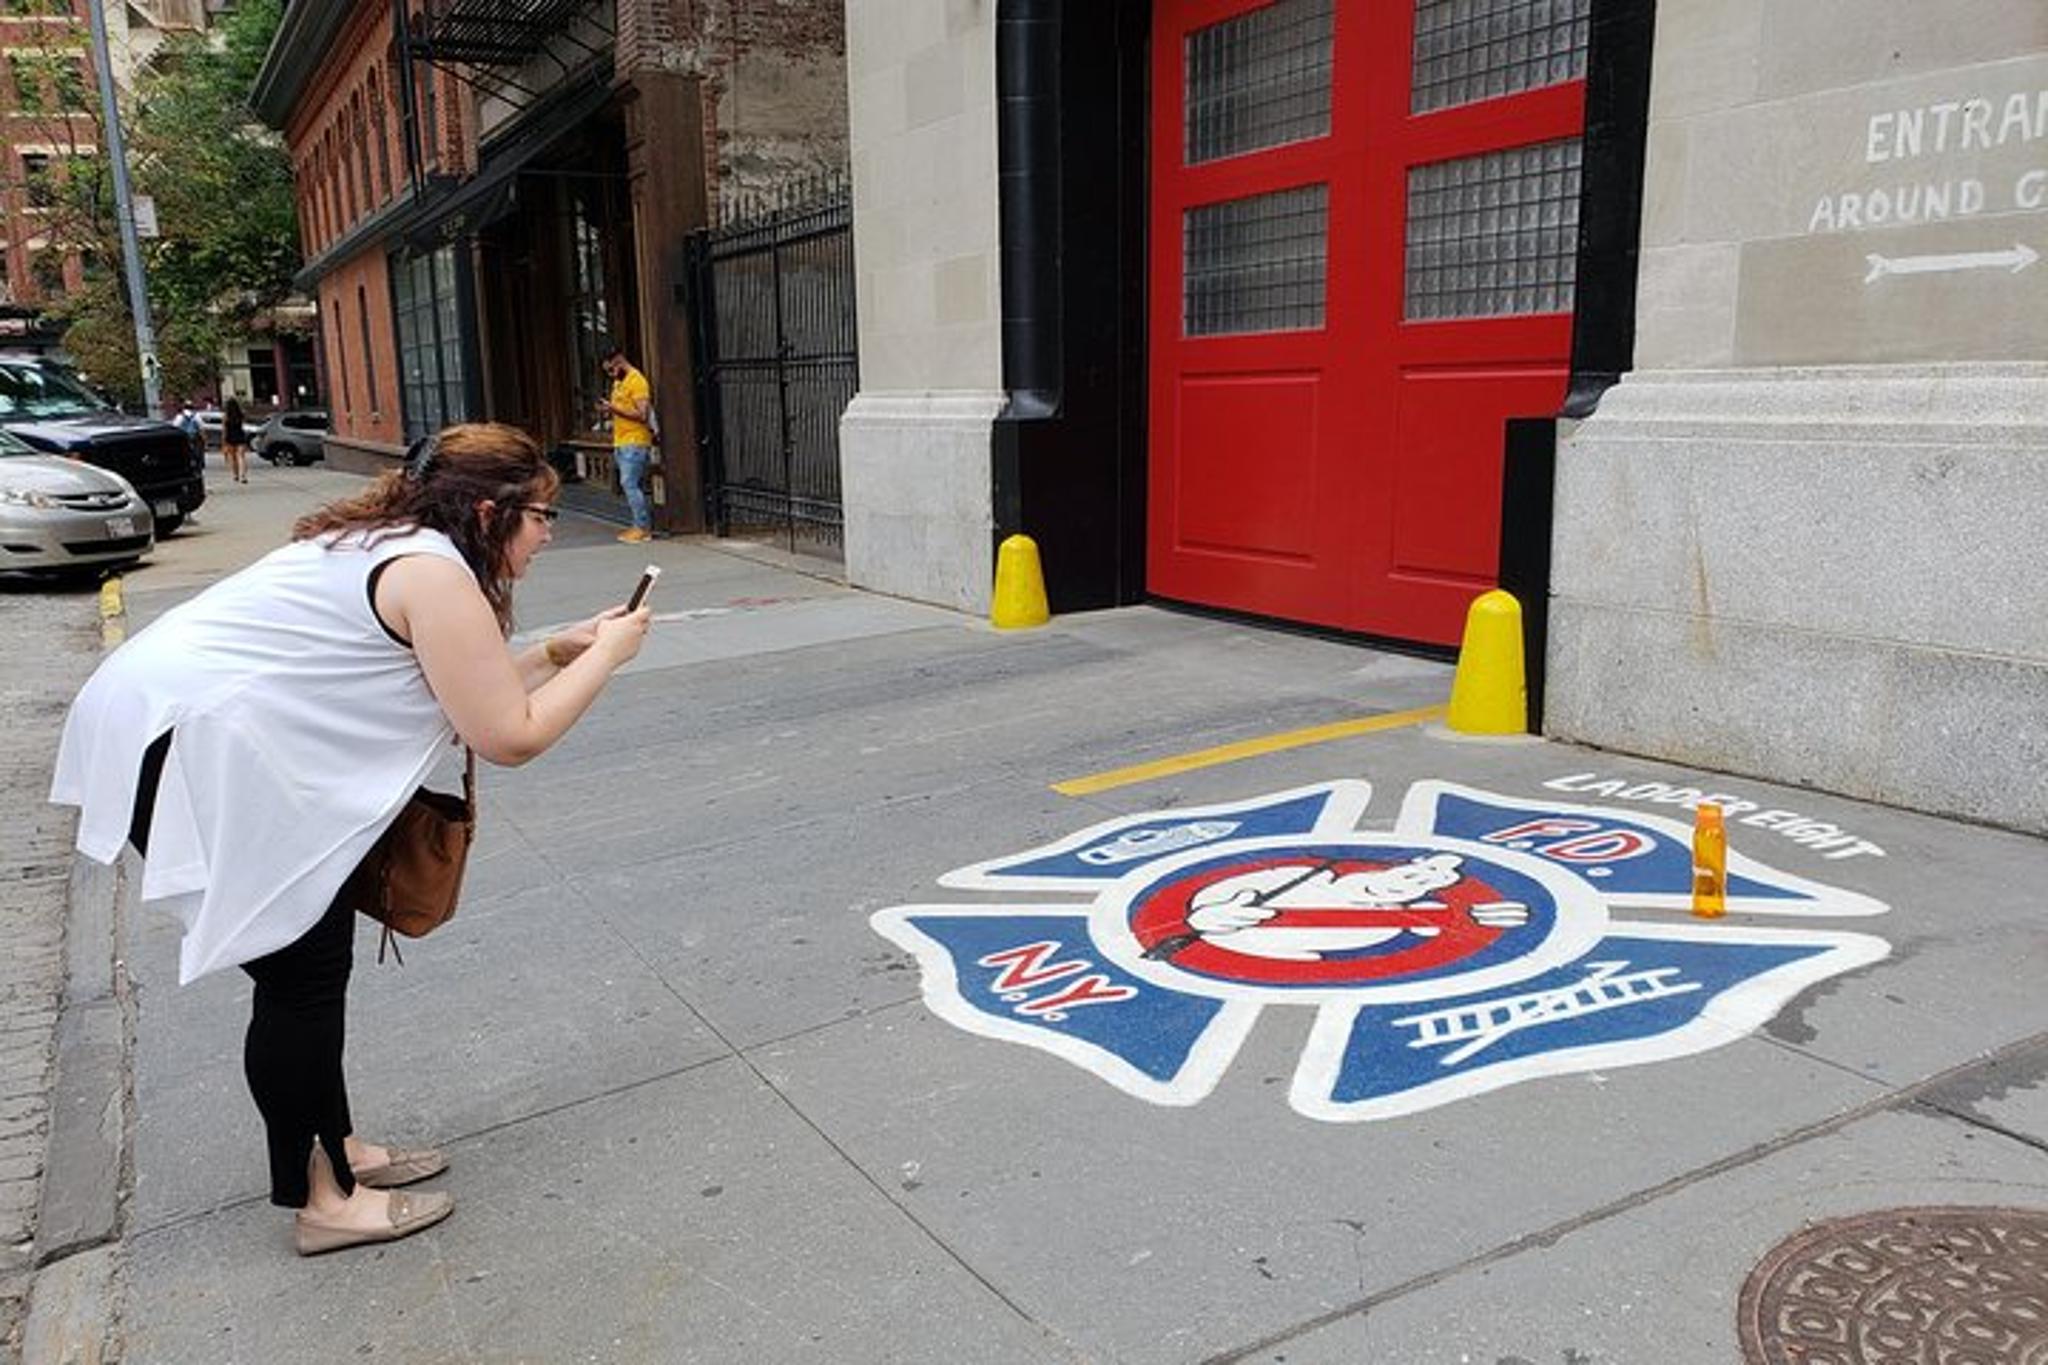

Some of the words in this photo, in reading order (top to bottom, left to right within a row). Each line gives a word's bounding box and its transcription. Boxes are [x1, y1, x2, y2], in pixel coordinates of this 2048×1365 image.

[1808, 180, 1984, 233] AROUND
[1479, 818, 1658, 878] F.D.
[1739, 809, 1886, 860] EIGHT
[978, 941, 1139, 1022] N.Y.
